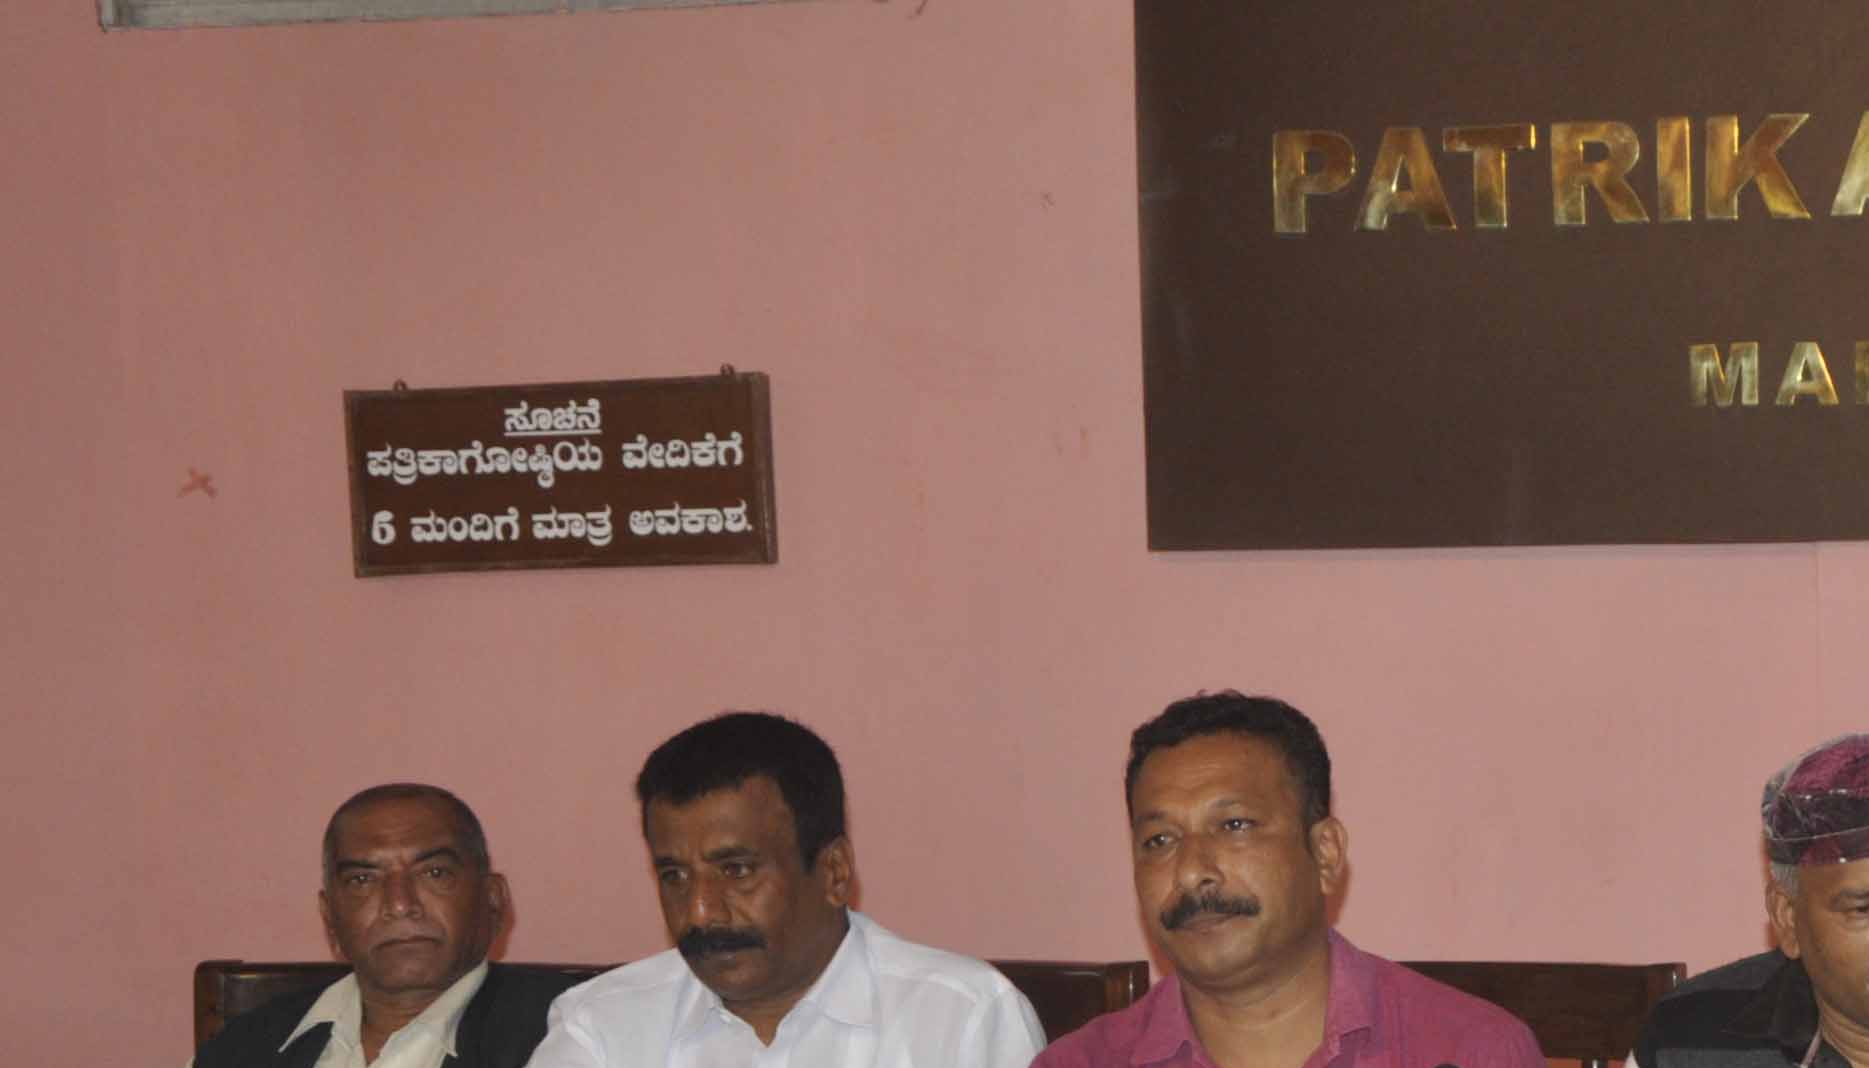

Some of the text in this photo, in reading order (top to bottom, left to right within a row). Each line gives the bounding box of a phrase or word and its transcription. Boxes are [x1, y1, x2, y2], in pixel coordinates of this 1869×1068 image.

[503, 397, 602, 432] ಸೂಚನೆ
[621, 431, 744, 470] ವೇದಿಕೆಗೆ
[371, 509, 396, 545] 6
[410, 506, 520, 543] ಮಂದಿಗೆ
[531, 504, 613, 546] ಮಾತ್ರ
